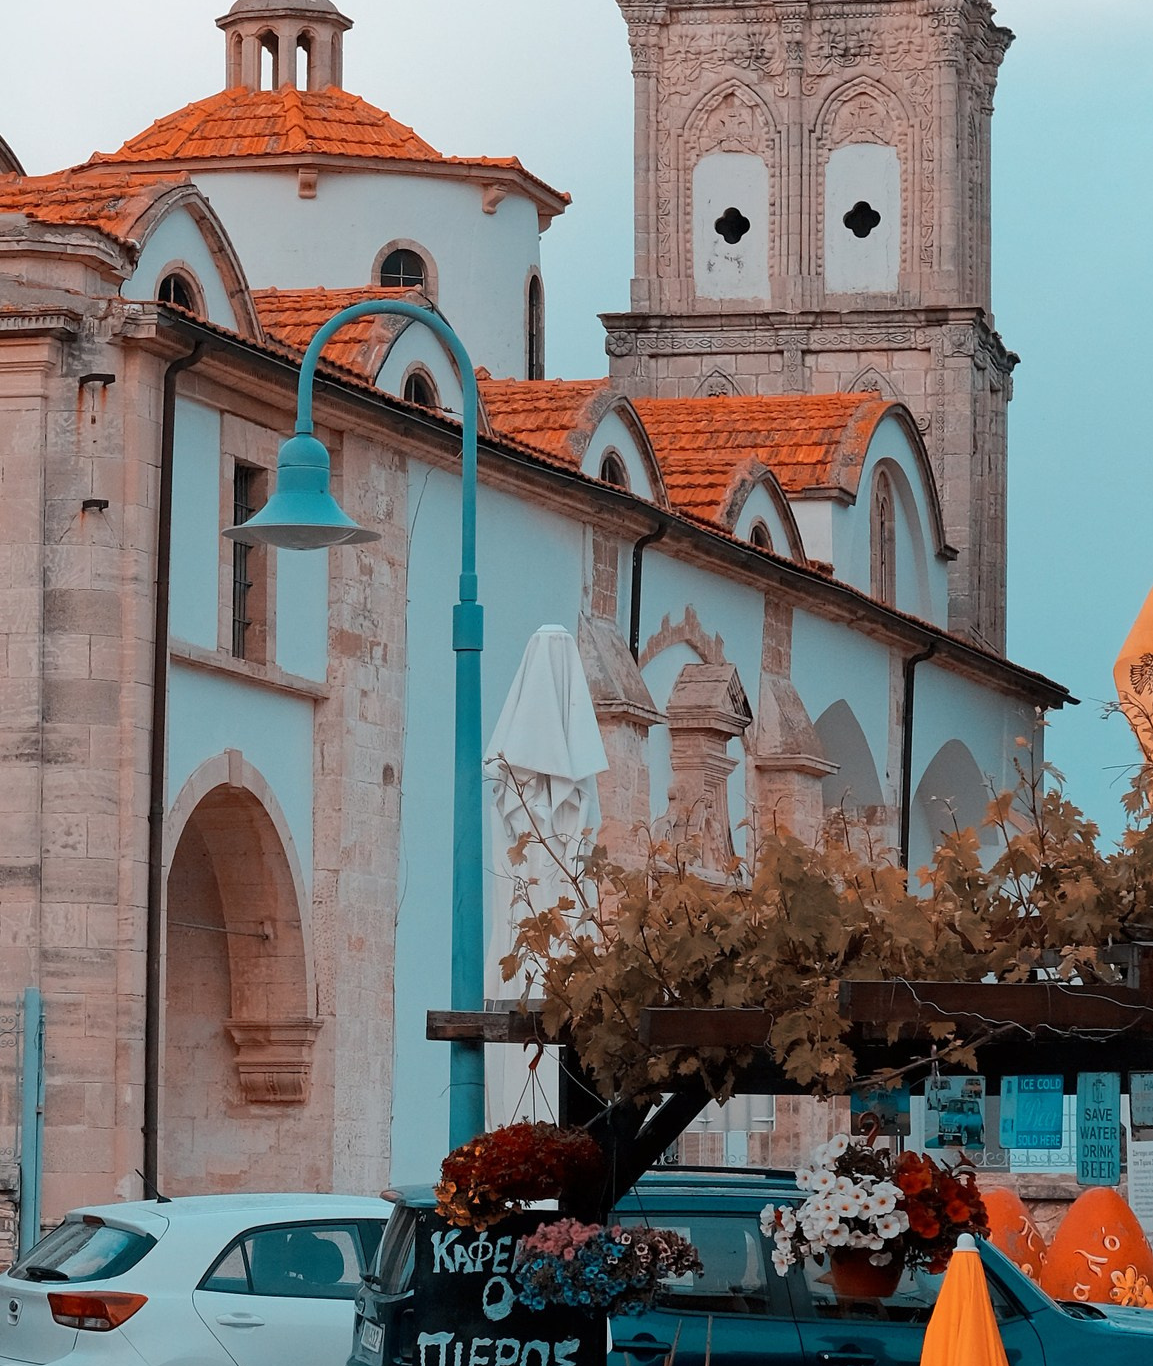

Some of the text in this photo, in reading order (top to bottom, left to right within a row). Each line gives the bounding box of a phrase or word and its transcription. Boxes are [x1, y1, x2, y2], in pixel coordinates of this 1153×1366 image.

[1021, 1079, 1061, 1090] ICE COLD
[1084, 1108, 1113, 1122] SAVE
[1080, 1127, 1117, 1140] WATER
[1018, 1135, 1061, 1146] SOLD HERE
[1083, 1145, 1114, 1159] DRINK
[1081, 1161, 1115, 1179] BEER
